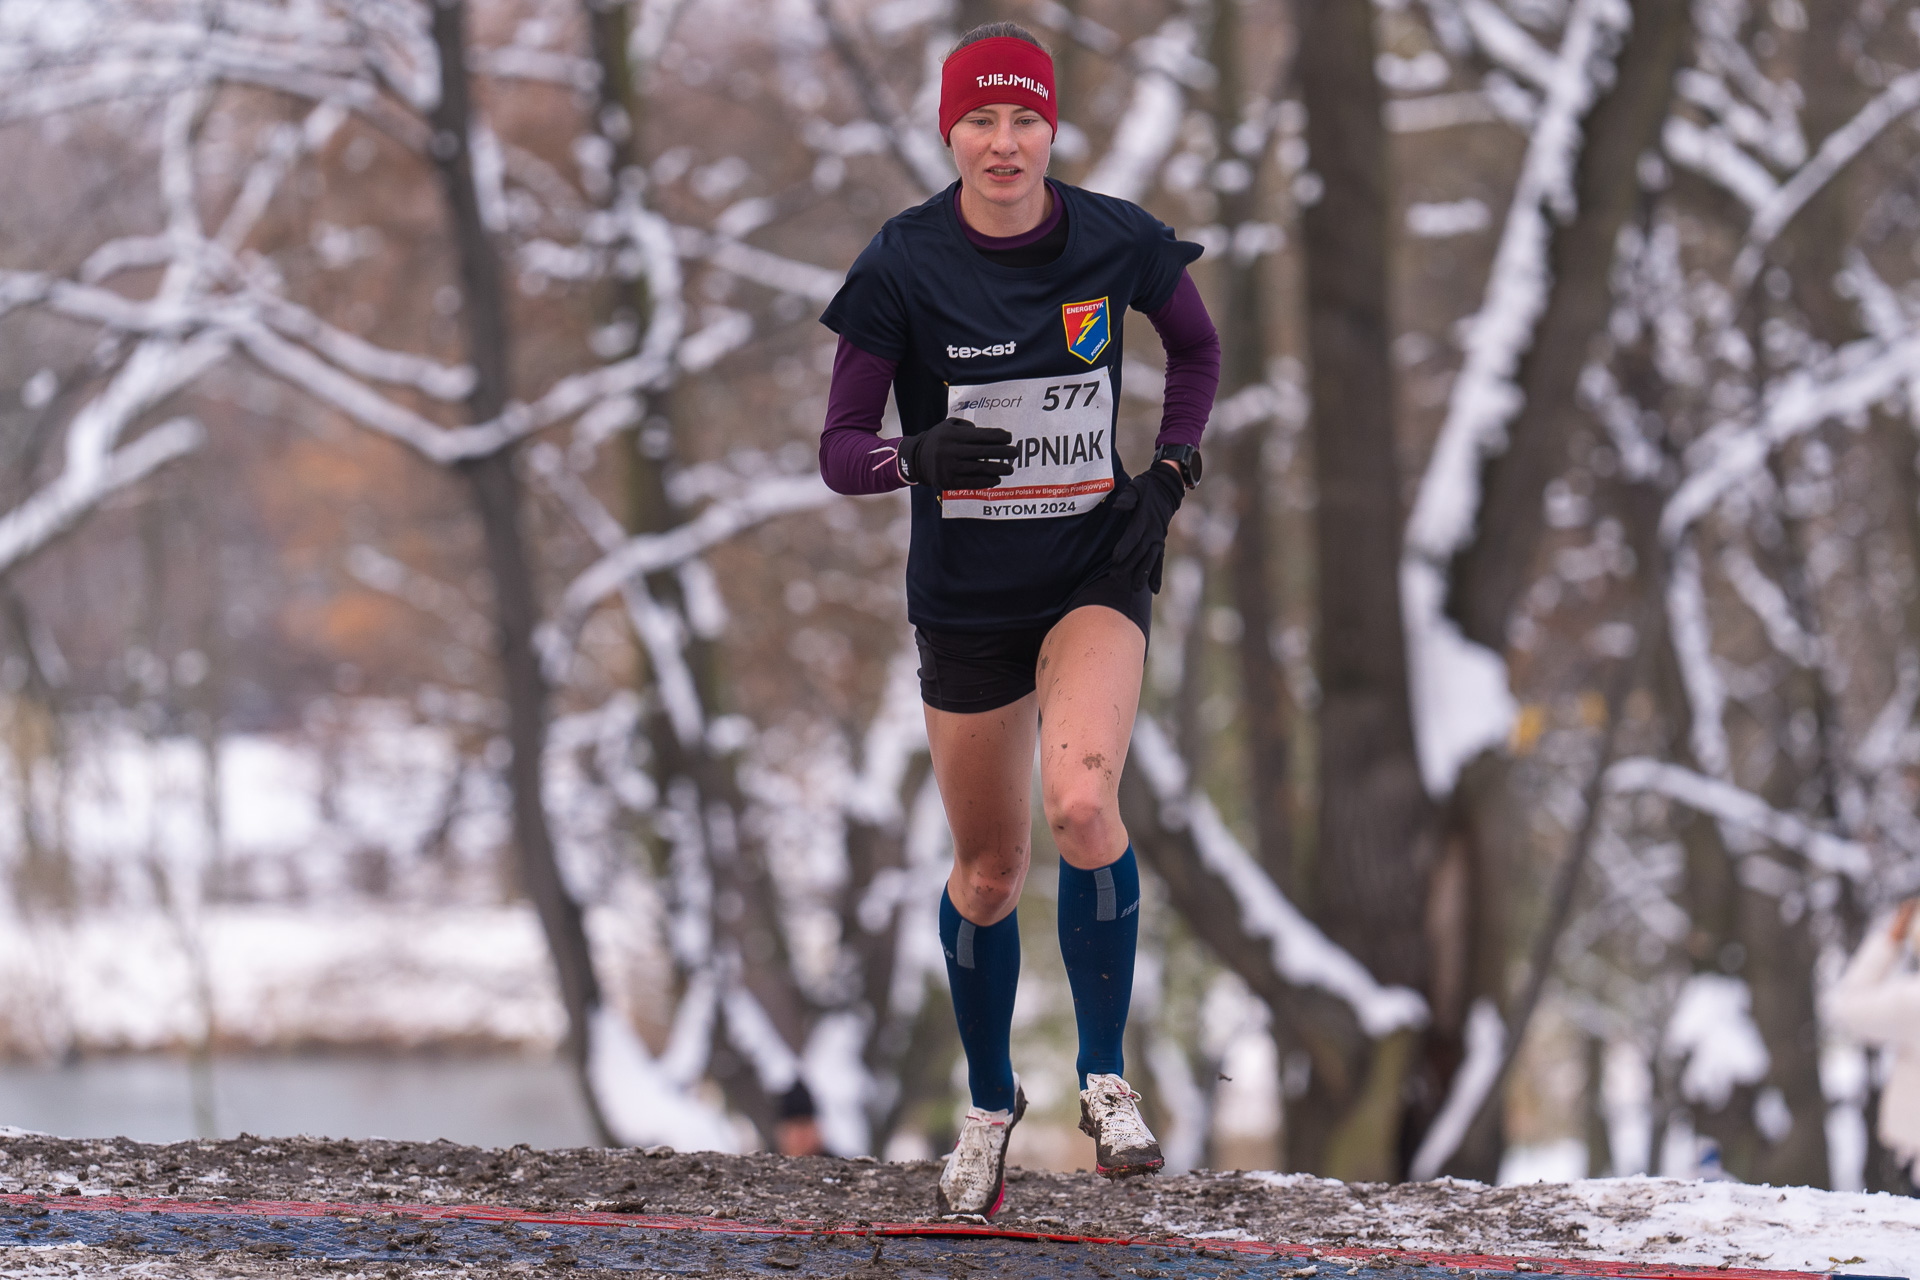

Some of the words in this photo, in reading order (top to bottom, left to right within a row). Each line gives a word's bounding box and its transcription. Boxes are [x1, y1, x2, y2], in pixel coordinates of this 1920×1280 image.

[976, 73, 1049, 101] TJEJMILEN
[1066, 302, 1104, 314] ENERGETYK
[1042, 381, 1100, 411] 577
[1042, 487, 1070, 495] Biegach
[983, 504, 1037, 516] BYTOM
[1040, 501, 1076, 514] 2024
